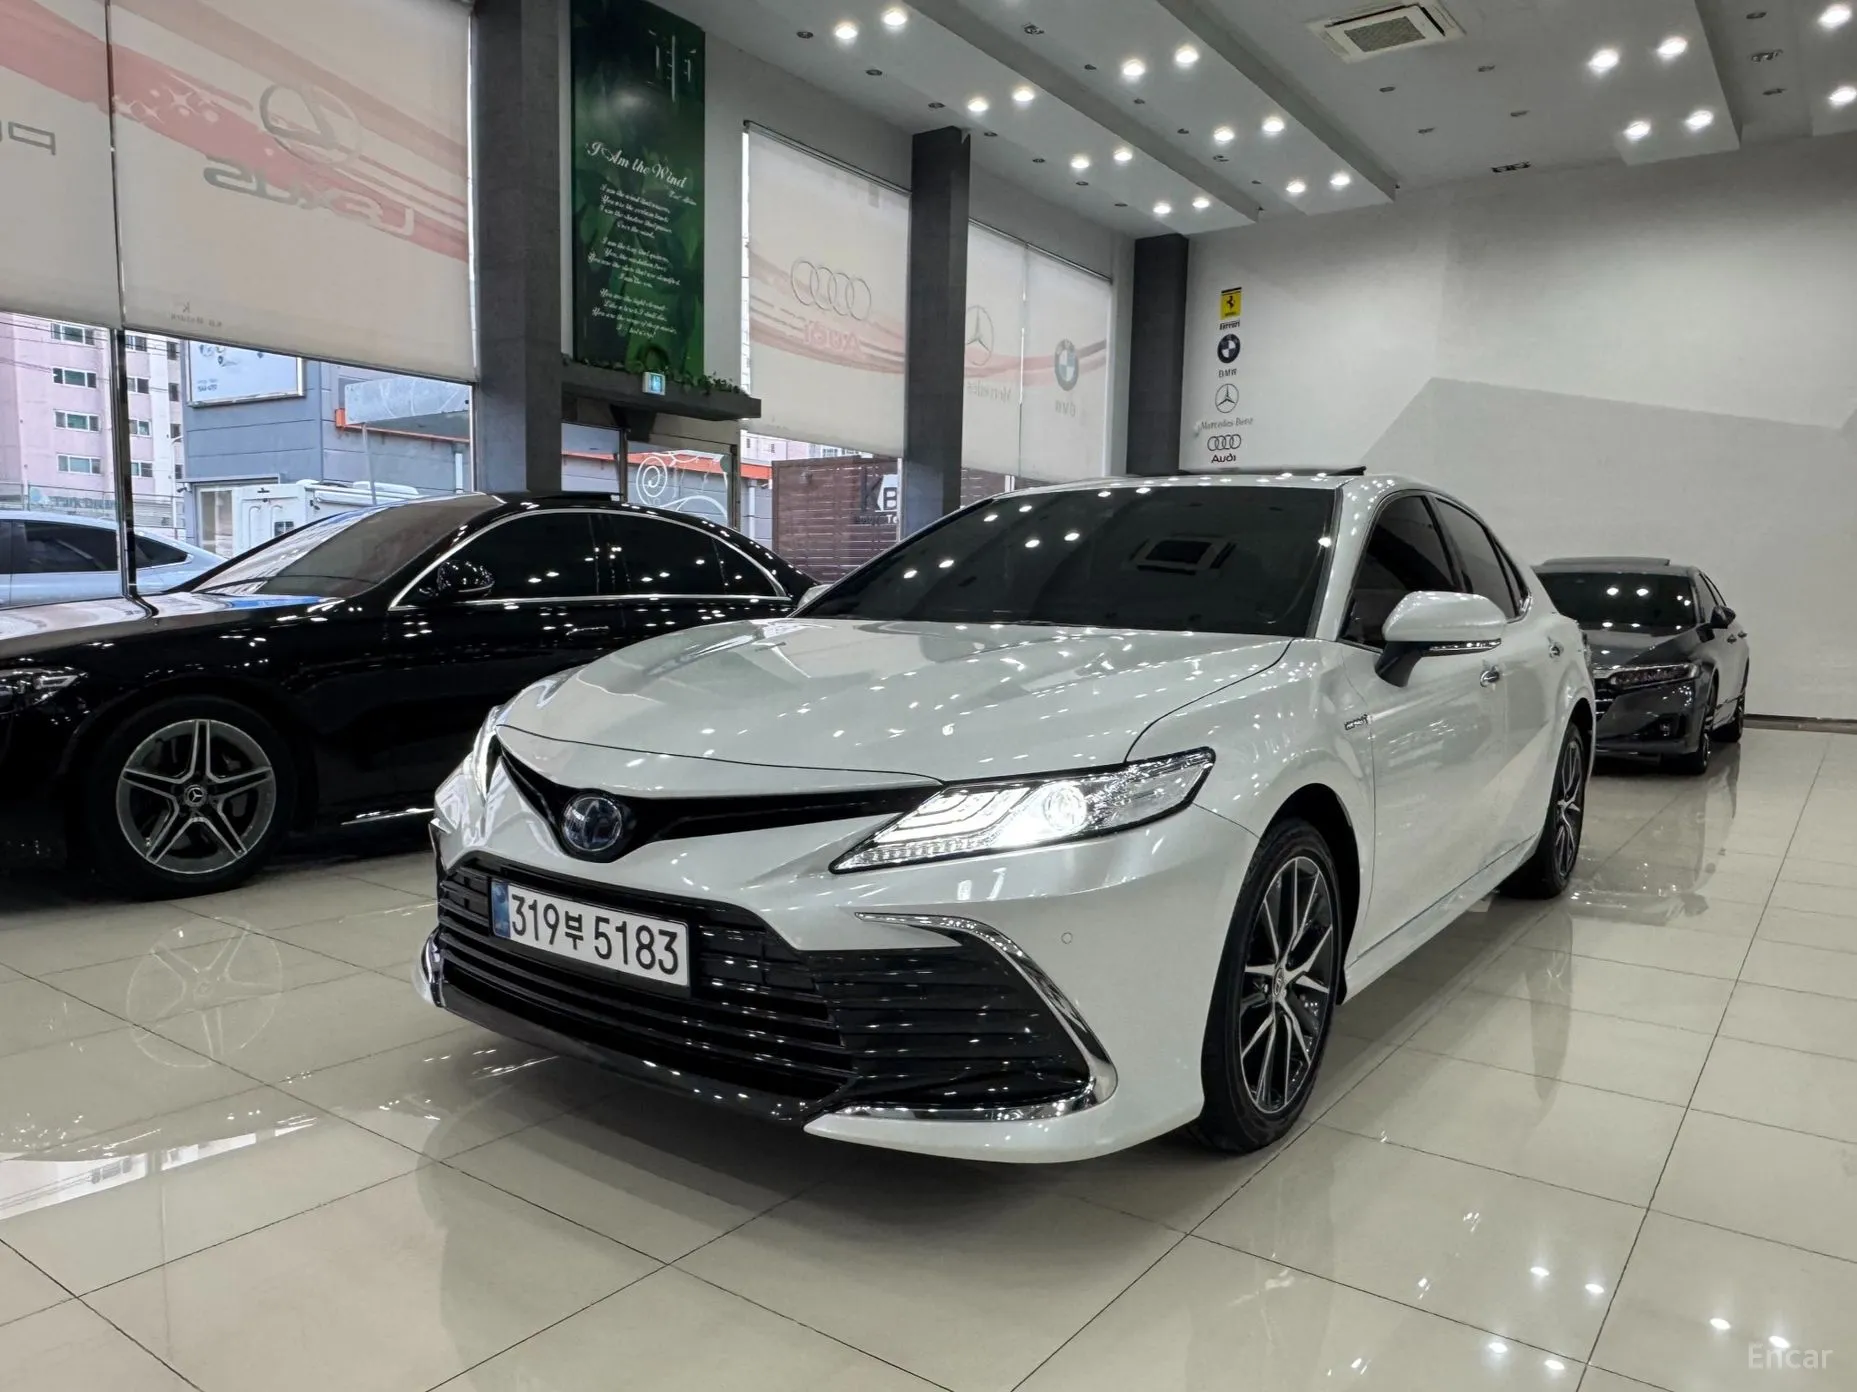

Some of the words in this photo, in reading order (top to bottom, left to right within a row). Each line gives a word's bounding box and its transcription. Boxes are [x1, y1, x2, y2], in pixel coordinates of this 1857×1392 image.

[585, 141, 606, 156] I
[601, 147, 630, 168] Am
[632, 158, 651, 176] the
[651, 163, 688, 188] Wind
[1218, 368, 1238, 378] BMW
[1211, 453, 1236, 463] Audi
[511, 893, 584, 951] 319부
[594, 915, 679, 976] 5183
